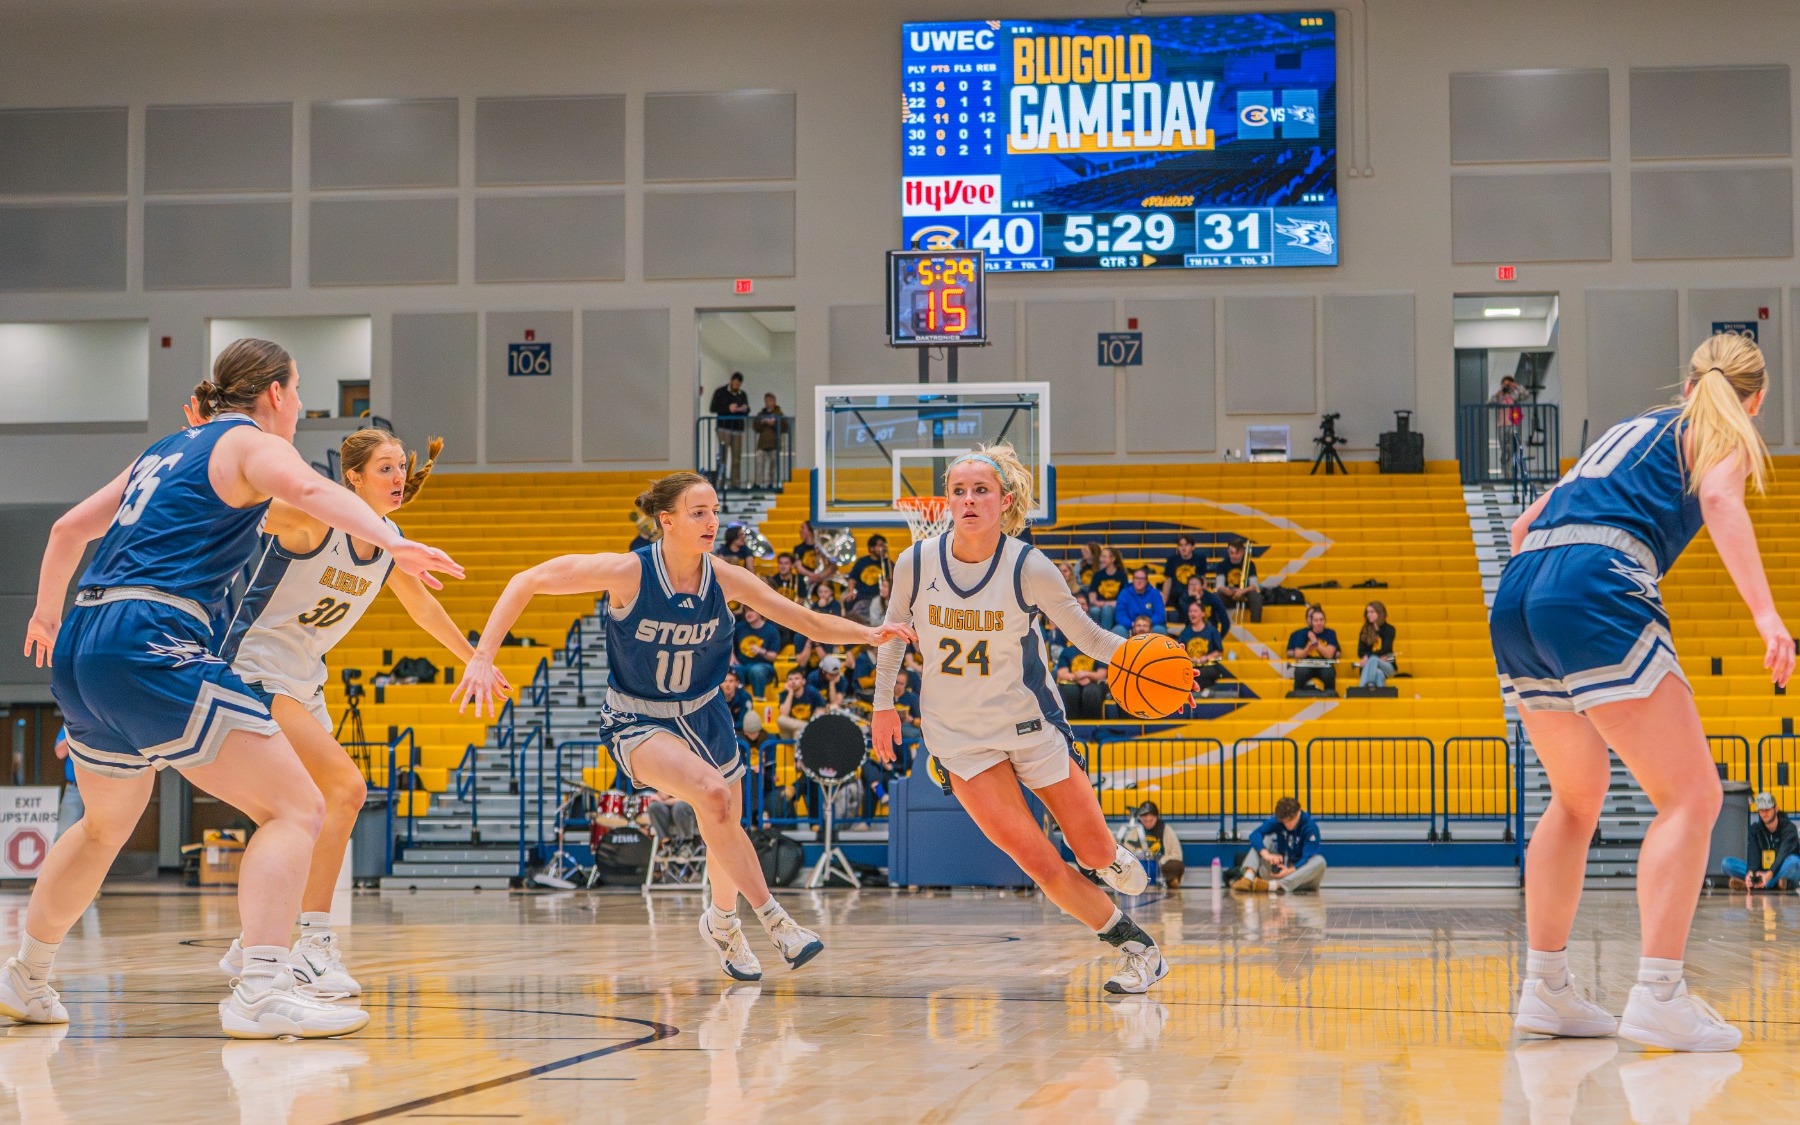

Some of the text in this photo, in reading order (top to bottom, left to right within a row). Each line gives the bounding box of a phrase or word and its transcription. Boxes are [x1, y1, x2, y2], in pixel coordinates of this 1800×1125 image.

[910, 30, 995, 51] UWEC
[907, 63, 997, 74] PLY PTS FLS REB
[1013, 34, 1152, 85] BLUGOLD
[908, 80, 992, 93] 13 4 0 2
[908, 97, 926, 108] 22
[960, 96, 968, 107] 1
[983, 95, 991, 107] 1
[908, 111, 996, 124] 24 11 0 12
[1010, 80, 1215, 150] GAMEDAY
[1270, 107, 1286, 122] VS
[908, 128, 991, 141] 30 0 0 1
[908, 143, 991, 156] 32 0 2 1
[972, 217, 1034, 255] 40
[1063, 213, 1175, 253] 5:29
[1203, 212, 1260, 250] 31
[918, 259, 974, 285] 5:29
[1004, 260, 1012, 269] 2
[1020, 261, 1038, 269] TOL
[1041, 259, 1049, 269] 4
[1100, 255, 1138, 268] QTR 3
[1189, 257, 1202, 266] TM
[1223, 256, 1232, 265] 4
[1240, 256, 1257, 265] TOL
[1261, 255, 1269, 265] 3
[928, 288, 967, 332] 15
[510, 350, 550, 374] 106
[1101, 340, 1140, 364] 107
[298, 596, 351, 628] 30
[928, 604, 1004, 632] BLUGOLDS
[635, 617, 720, 645] STOUT
[938, 636, 991, 677] 24
[655, 650, 695, 694] 10
[15, 797, 42, 808] EXIT
